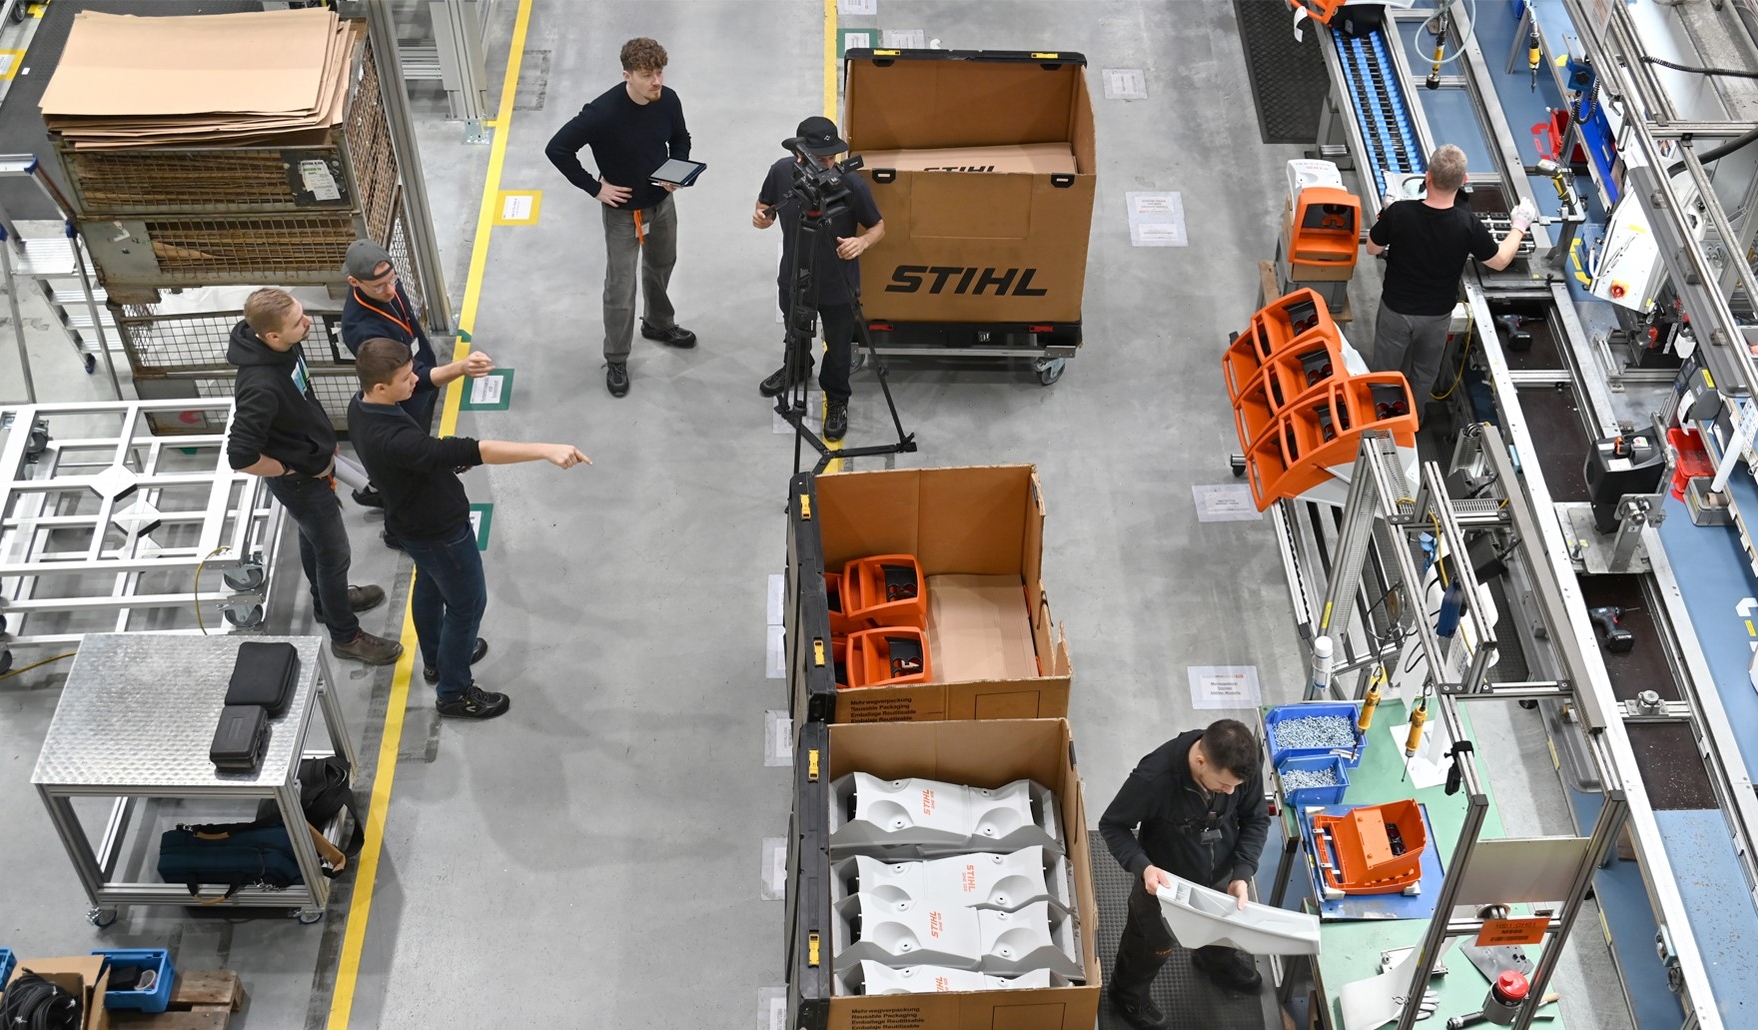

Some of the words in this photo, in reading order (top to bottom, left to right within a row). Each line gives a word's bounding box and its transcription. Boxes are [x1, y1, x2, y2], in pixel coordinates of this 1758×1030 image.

[885, 265, 1048, 296] STIHL
[922, 789, 931, 816] STIHL
[966, 864, 976, 892] STIHL
[929, 910, 939, 939] STIHL
